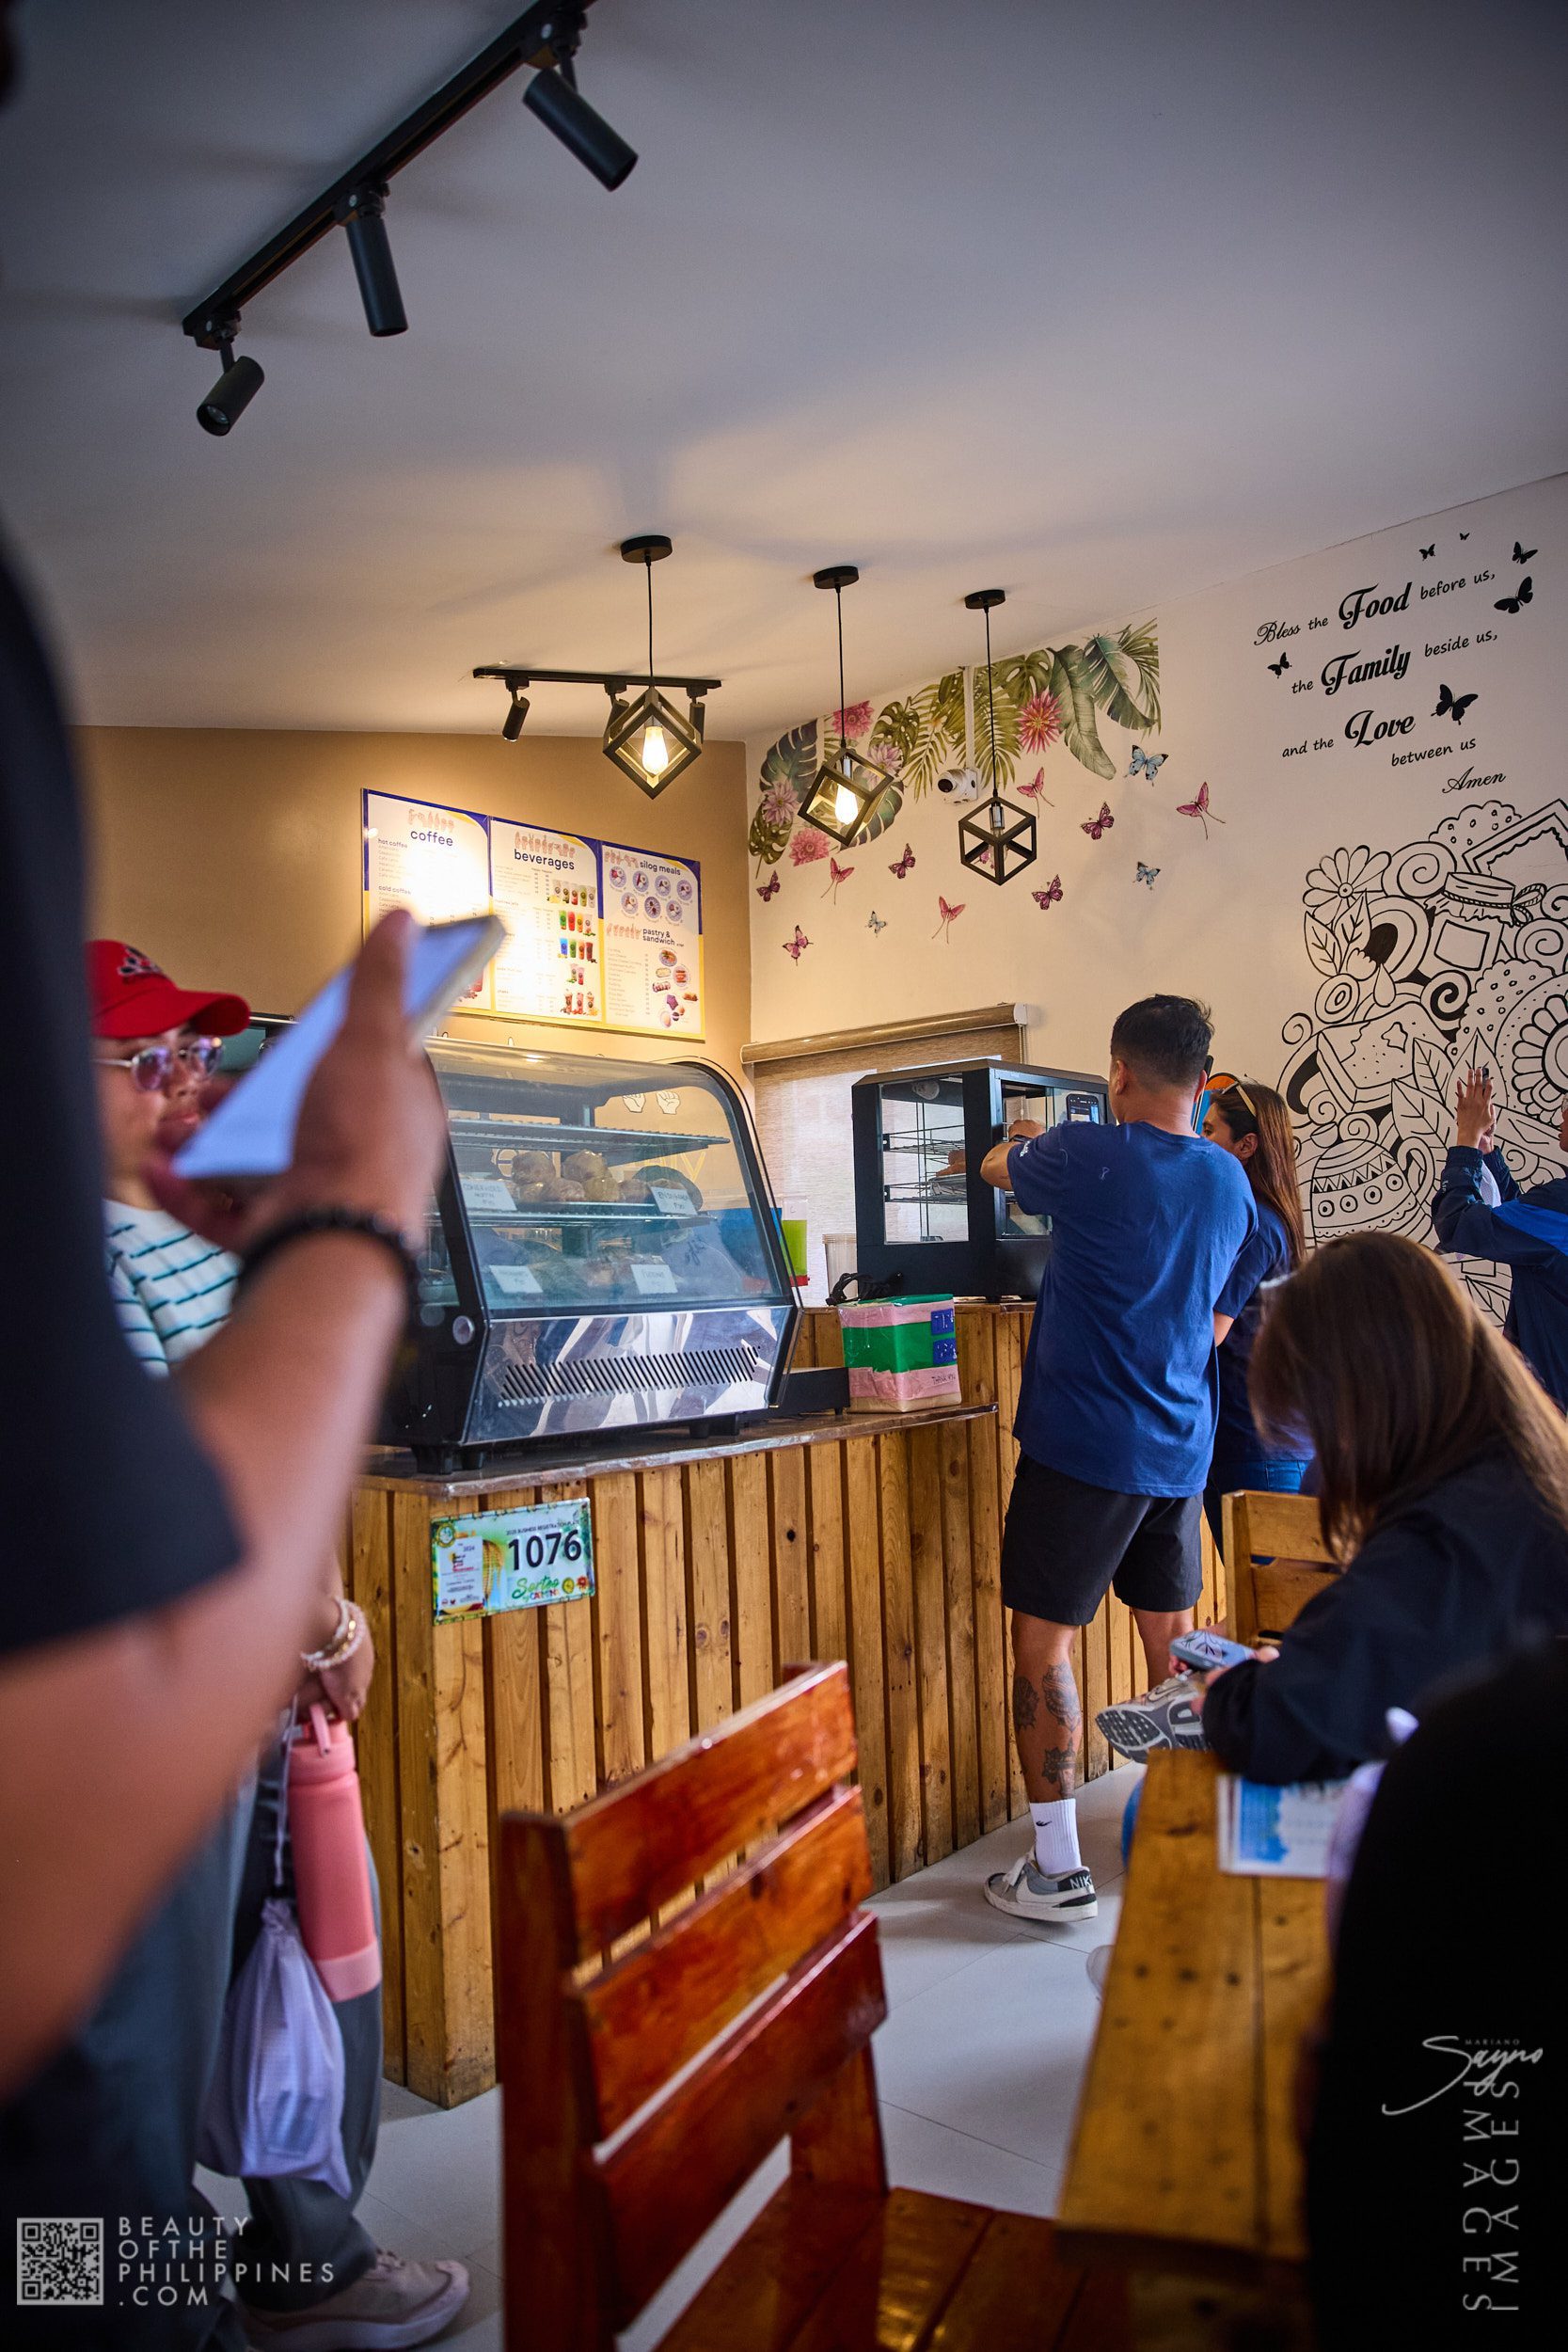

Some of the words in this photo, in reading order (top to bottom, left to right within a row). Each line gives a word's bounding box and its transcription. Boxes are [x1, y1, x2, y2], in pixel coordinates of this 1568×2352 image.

[1253, 620, 1302, 646] Bless
[1307, 616, 1329, 630] the
[1338, 581, 1413, 630] Food
[1419, 578, 1466, 600] before
[1473, 569, 1496, 583] us,
[1291, 679, 1314, 694] the
[1321, 644, 1412, 696] Family
[1424, 635, 1470, 658] beside
[1476, 629, 1497, 643] us,
[1281, 740, 1308, 758] and
[1313, 737, 1335, 751] the
[1344, 709, 1417, 749] Love
[1391, 745, 1453, 767] between
[1460, 738, 1477, 751] us
[1441, 766, 1507, 794] Amen
[410, 831, 453, 847] coffee
[514, 849, 575, 870] beverages
[640, 861, 657, 872] silog
[658, 866, 681, 876] meals
[642, 929, 665, 938] pastry
[642, 935, 675, 946] sandwich
[508, 1529, 581, 1571] 1076
